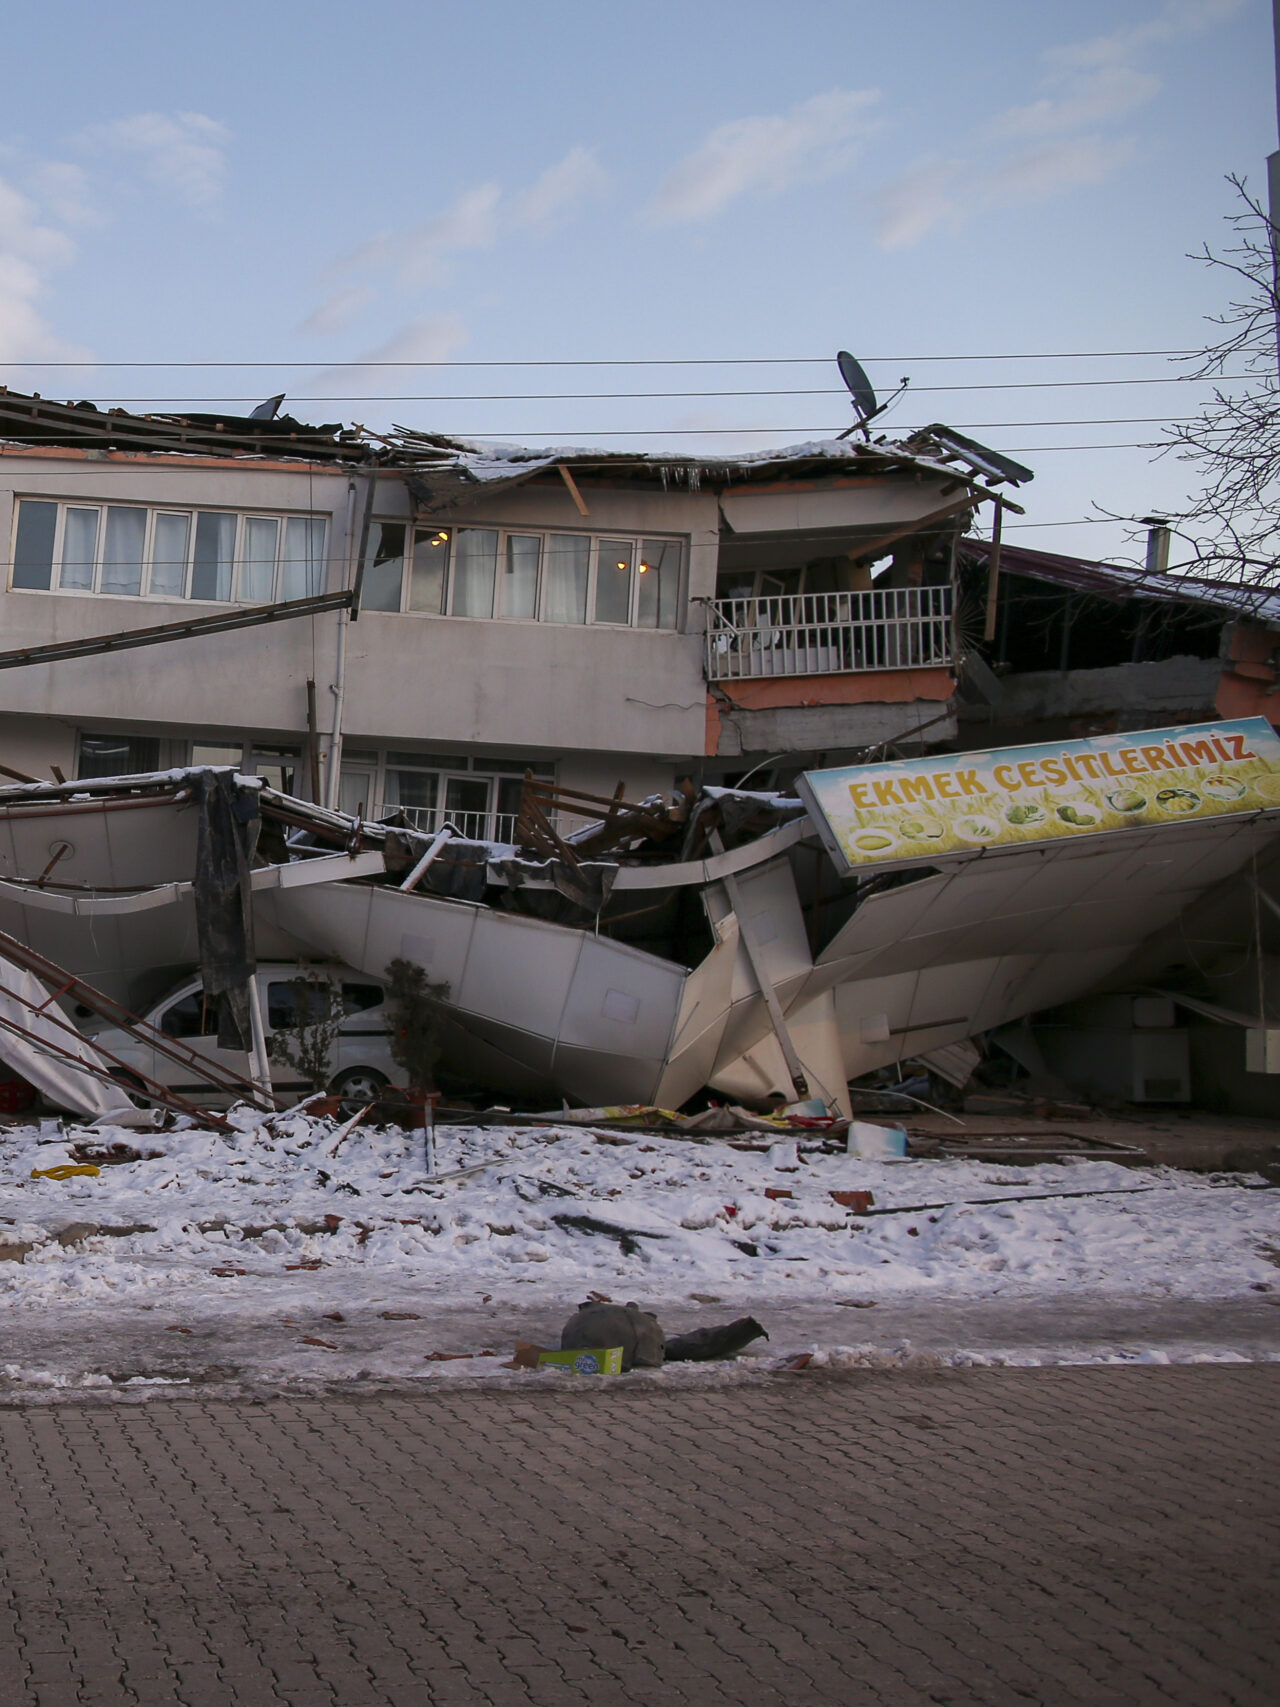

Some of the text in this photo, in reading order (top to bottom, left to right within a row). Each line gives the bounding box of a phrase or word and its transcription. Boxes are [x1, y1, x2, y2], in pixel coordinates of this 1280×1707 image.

[848, 734, 1257, 809] EKMEK ÇEŞİTLERİMİZ
[574, 1361, 599, 1370] green
